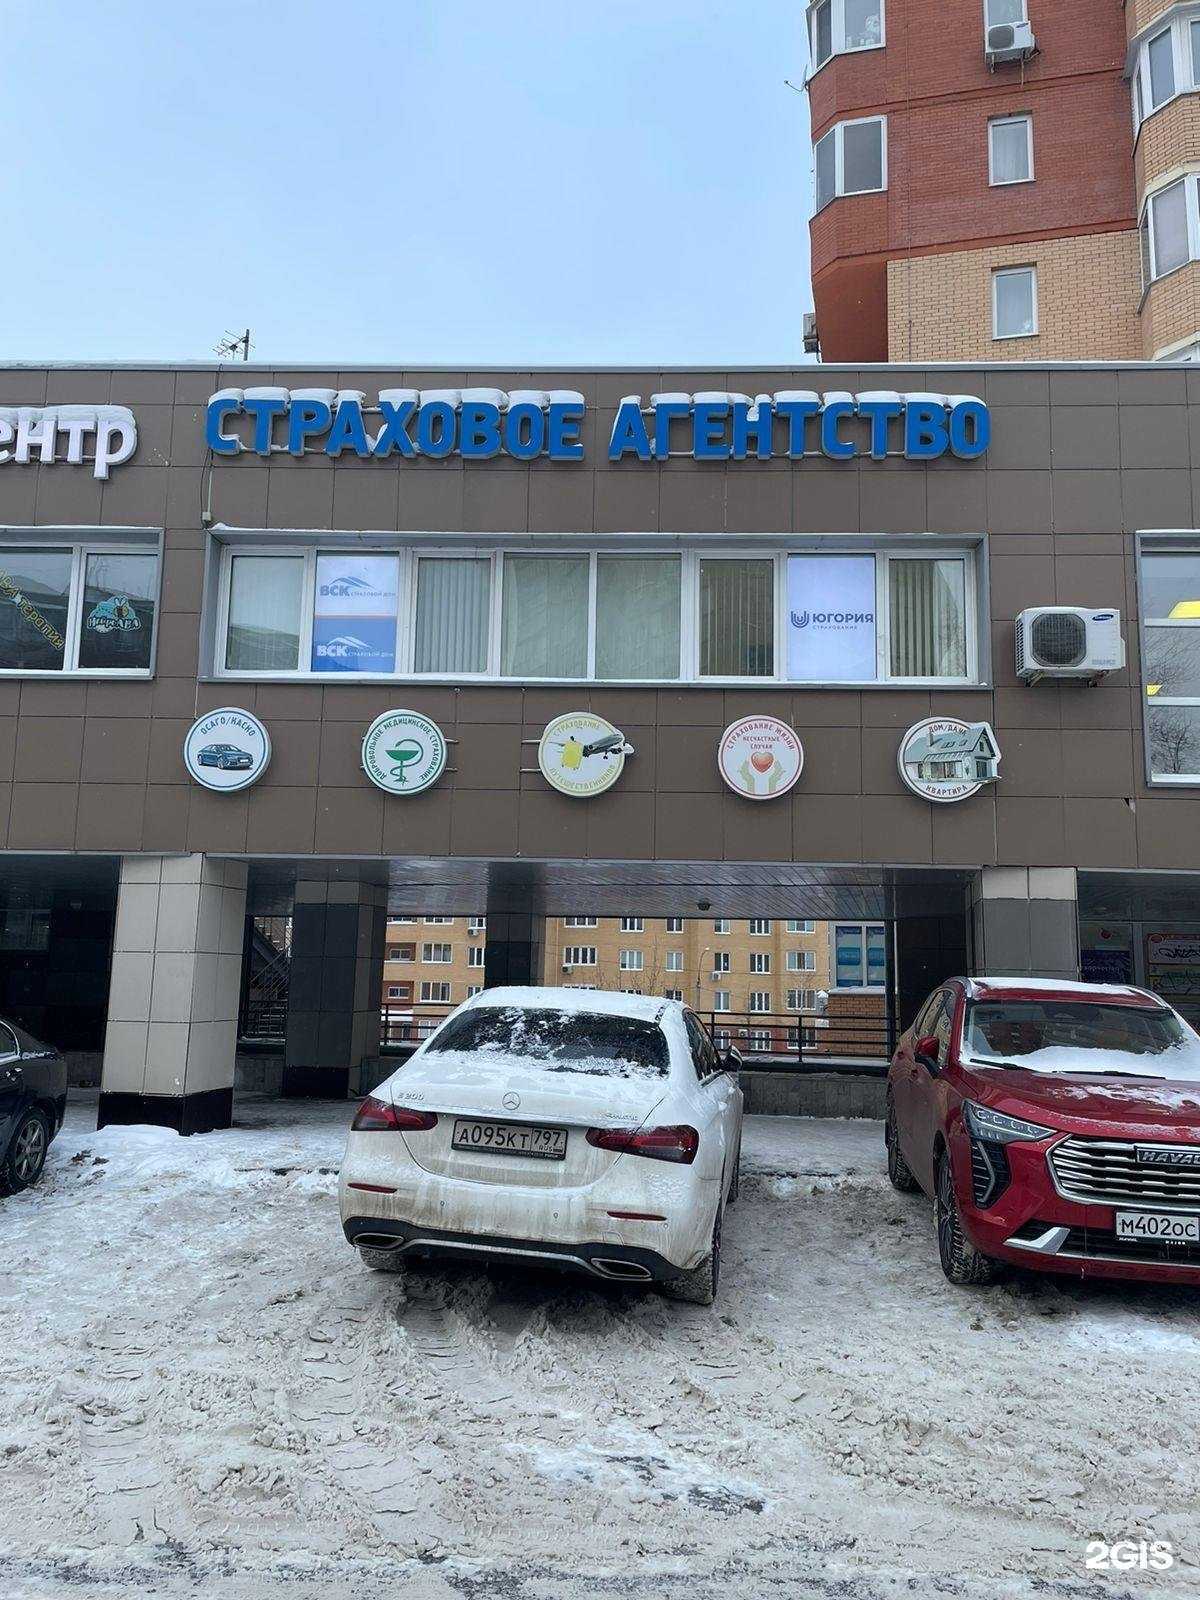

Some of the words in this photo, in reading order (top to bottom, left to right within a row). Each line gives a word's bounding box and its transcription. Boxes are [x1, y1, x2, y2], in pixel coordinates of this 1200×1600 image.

[206, 398, 586, 461] СТРАХОВОЕ
[608, 401, 992, 462] АГЕНТСТВО
[320, 585, 350, 596] ВСК
[812, 613, 874, 623] ЮГОРИЯ
[317, 645, 347, 657] ВСК
[727, 723, 774, 750] СТРАХОВАНИЕ
[774, 727, 795, 750] ЖИЗНИ
[384, 717, 432, 735] МЕДИЦИНСКОЕ
[419, 734, 441, 781] СТРАХОВАНИЕ
[925, 784, 968, 796] КВАРТИРА
[533, 1129, 563, 1147] 797
